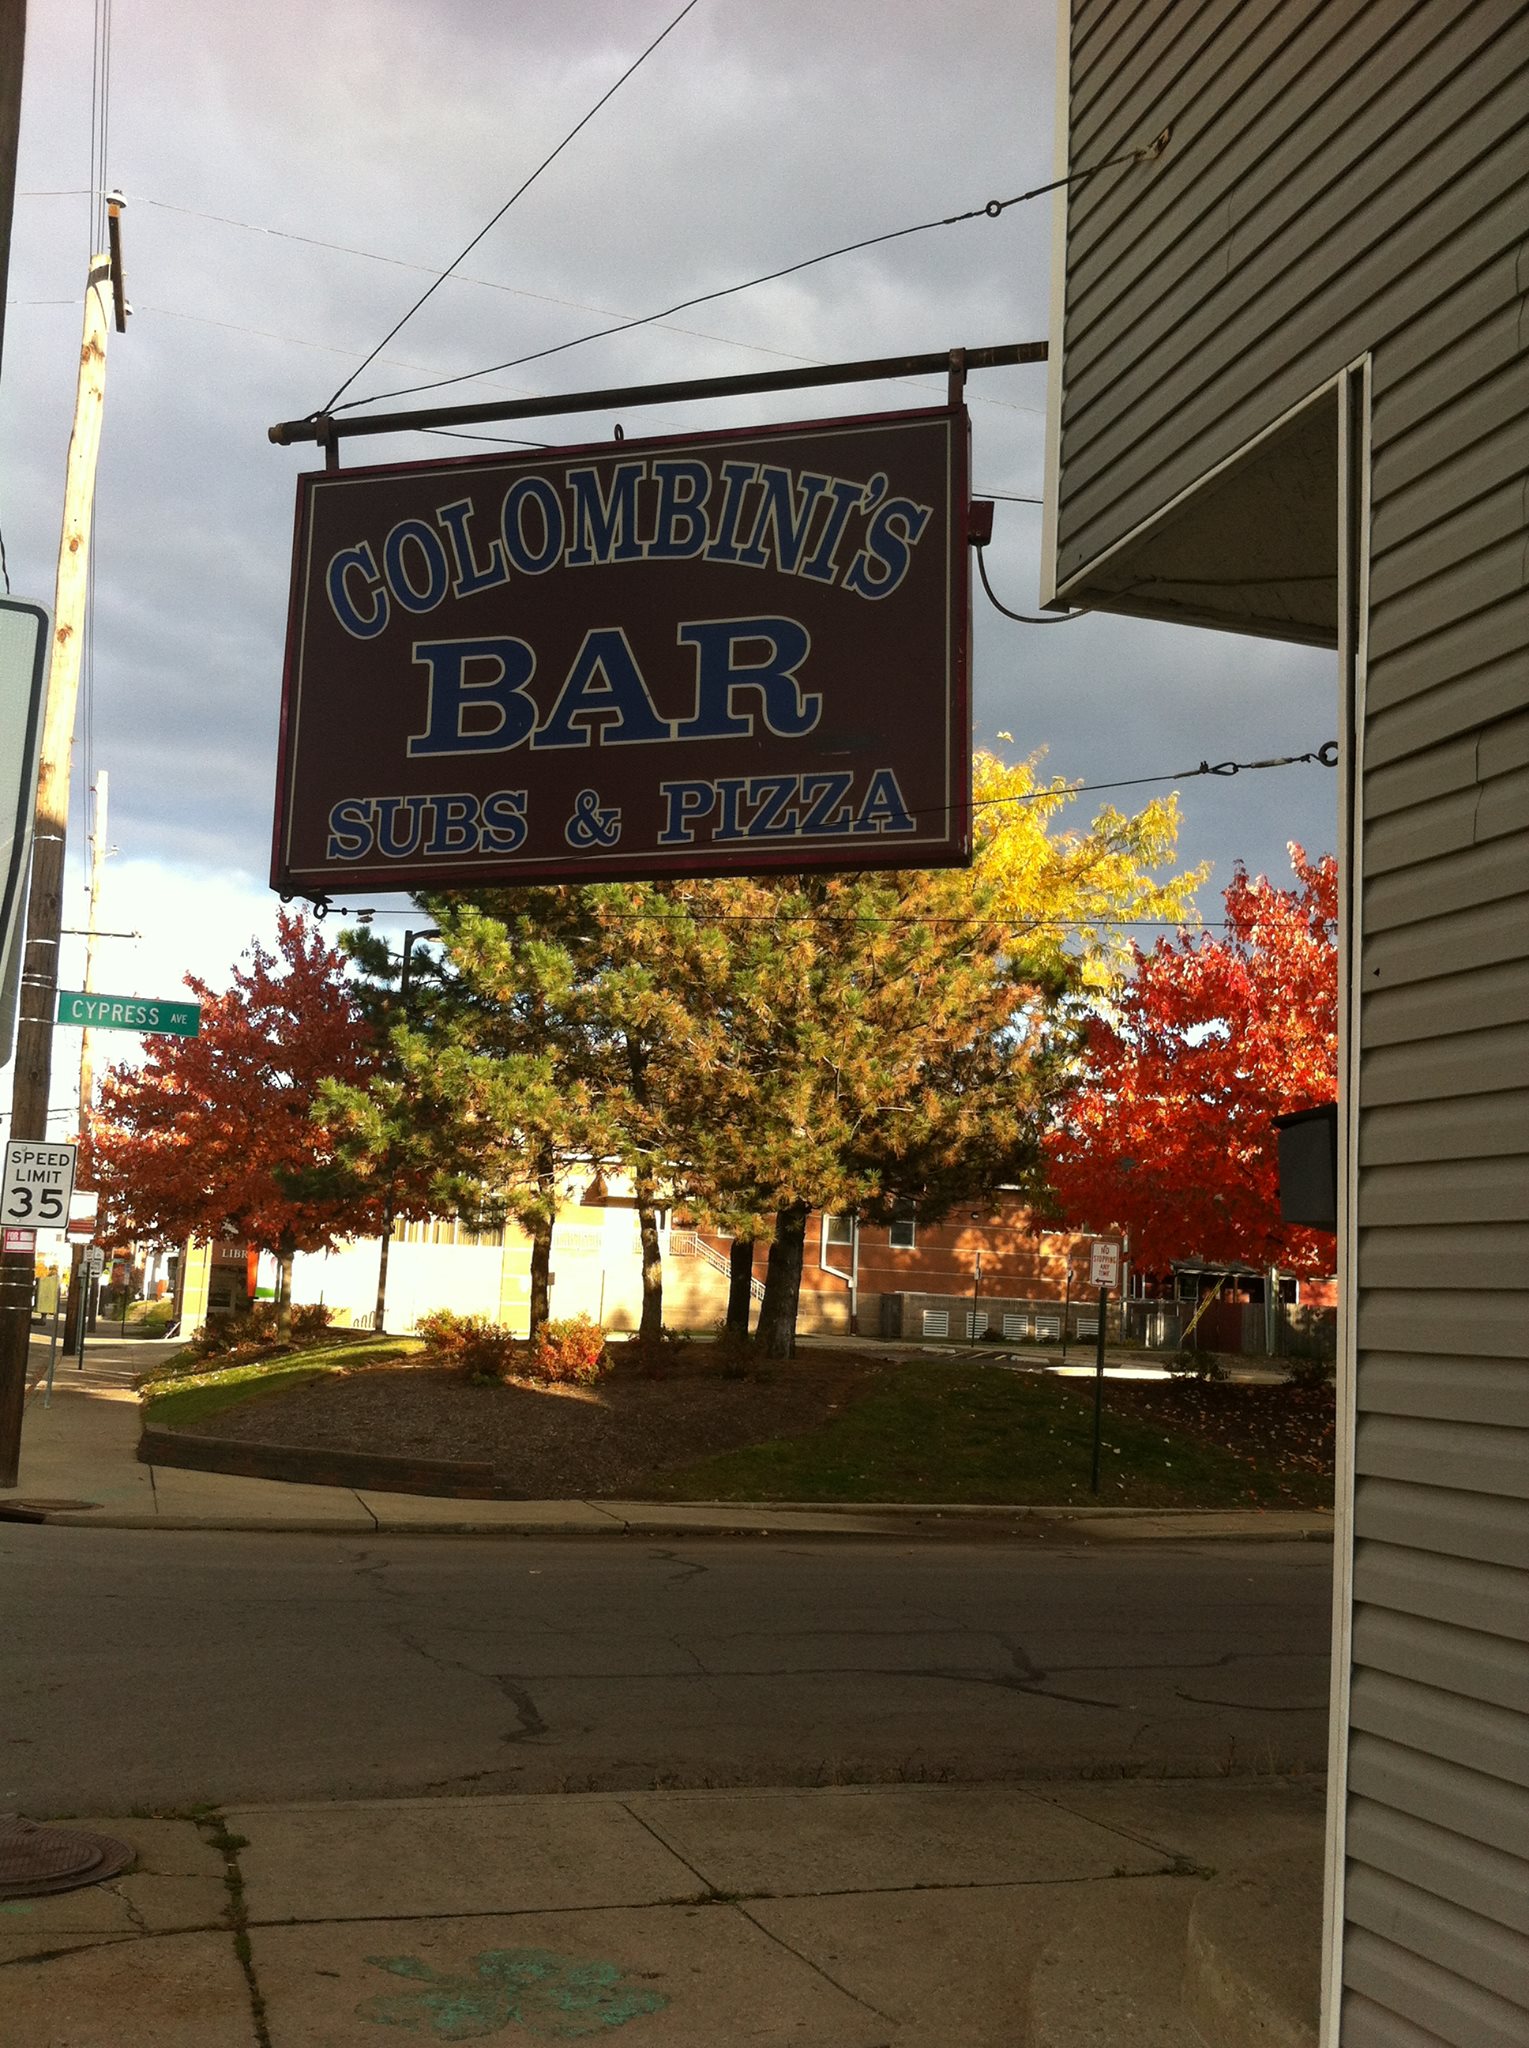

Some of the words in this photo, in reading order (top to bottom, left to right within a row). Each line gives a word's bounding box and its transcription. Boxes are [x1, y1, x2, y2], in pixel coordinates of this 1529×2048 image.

[326, 459, 933, 639] COLOMBINI'S
[406, 615, 823, 758] BAR
[326, 789, 528, 861] SUBS
[564, 788, 621, 849] &
[658, 768, 916, 845] PIZZA
[72, 1000, 160, 1025] CYPRESS
[170, 1013, 188, 1025] AVE
[11, 1151, 70, 1167] SPEED
[16, 1169, 62, 1183] LIMIT
[7, 1187, 63, 1219] 35
[1100, 1247, 1110, 1255] NO
